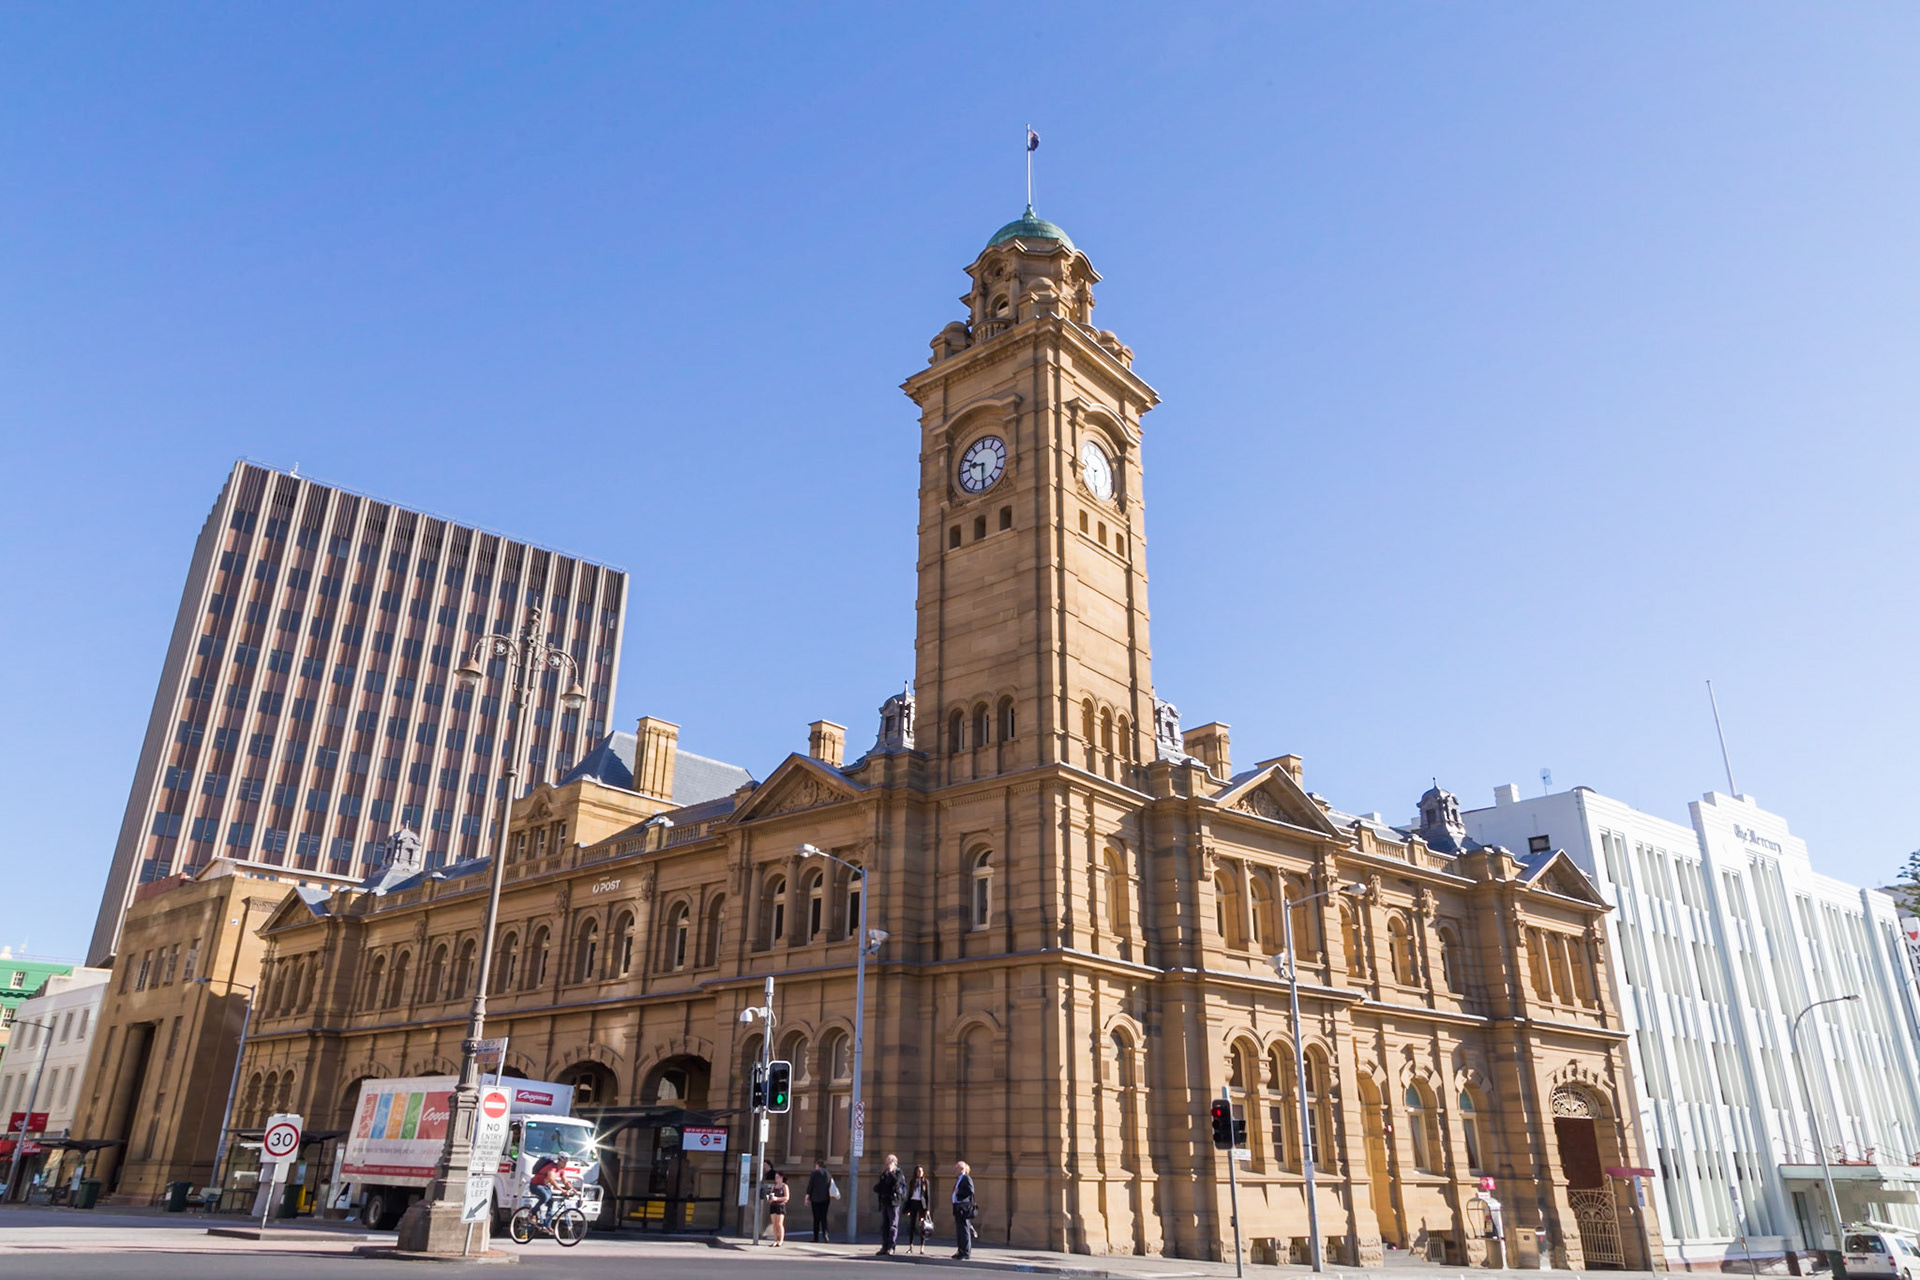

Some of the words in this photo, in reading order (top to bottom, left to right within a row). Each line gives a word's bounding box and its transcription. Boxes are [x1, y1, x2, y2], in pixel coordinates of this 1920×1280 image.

[600, 880, 621, 892] POST
[486, 1123, 500, 1131] NO
[271, 1132, 293, 1147] 30
[481, 1133, 503, 1141] ENTRY
[471, 1180, 490, 1188] KEEP
[471, 1189, 487, 1198] LEFT
